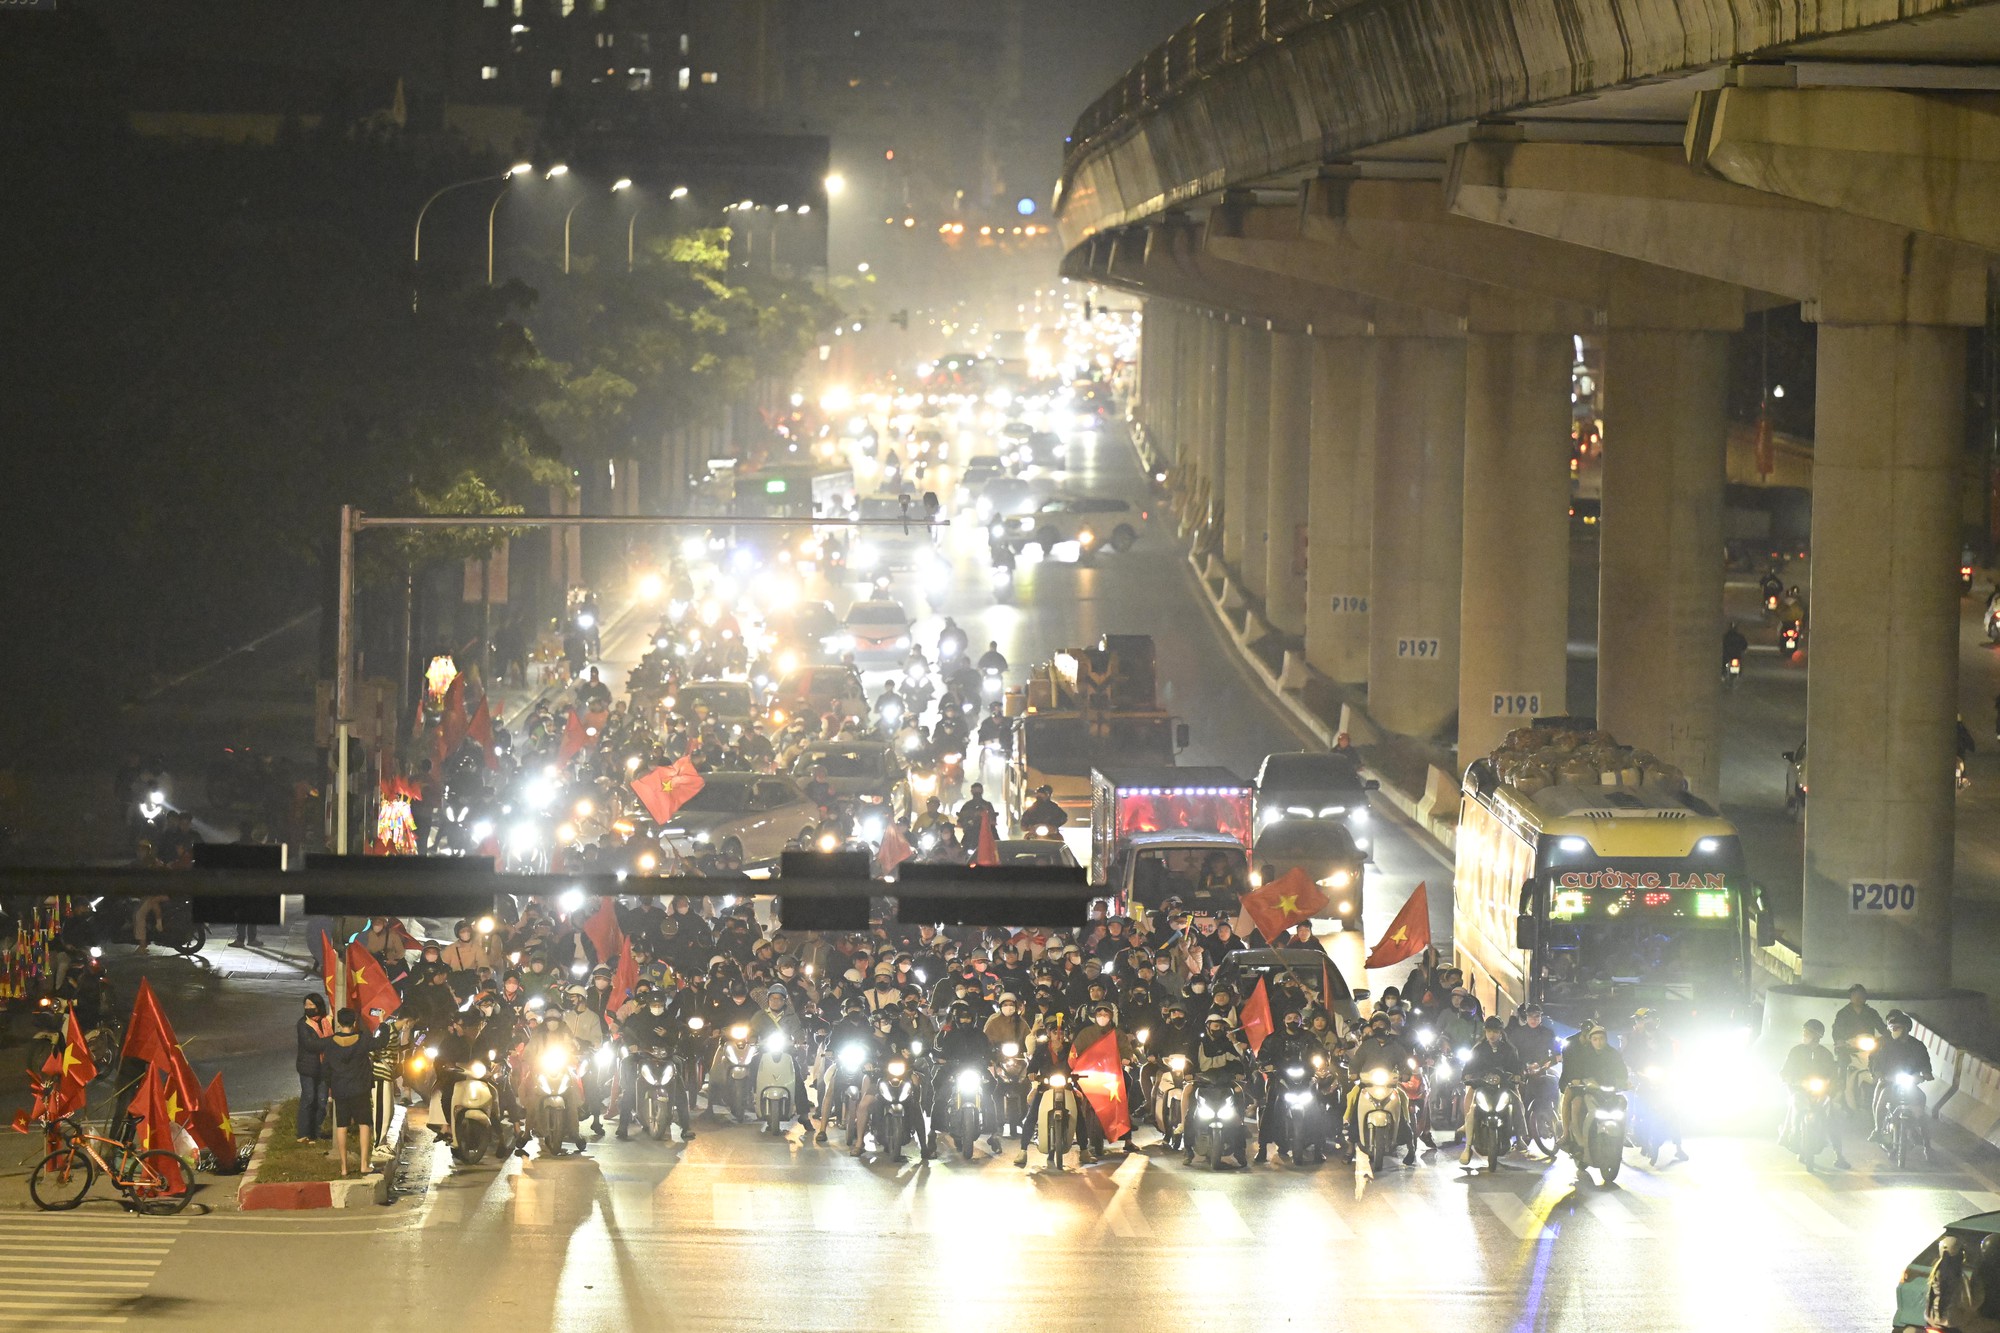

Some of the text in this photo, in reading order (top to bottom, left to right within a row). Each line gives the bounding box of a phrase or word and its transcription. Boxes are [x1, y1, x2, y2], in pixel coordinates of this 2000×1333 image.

[1332, 597, 1368, 612] P196
[1398, 640, 1438, 657] P197
[1494, 695, 1539, 714] P198
[1560, 867, 1726, 890] CƯỜNG LAN
[1852, 883, 1915, 910] P200
